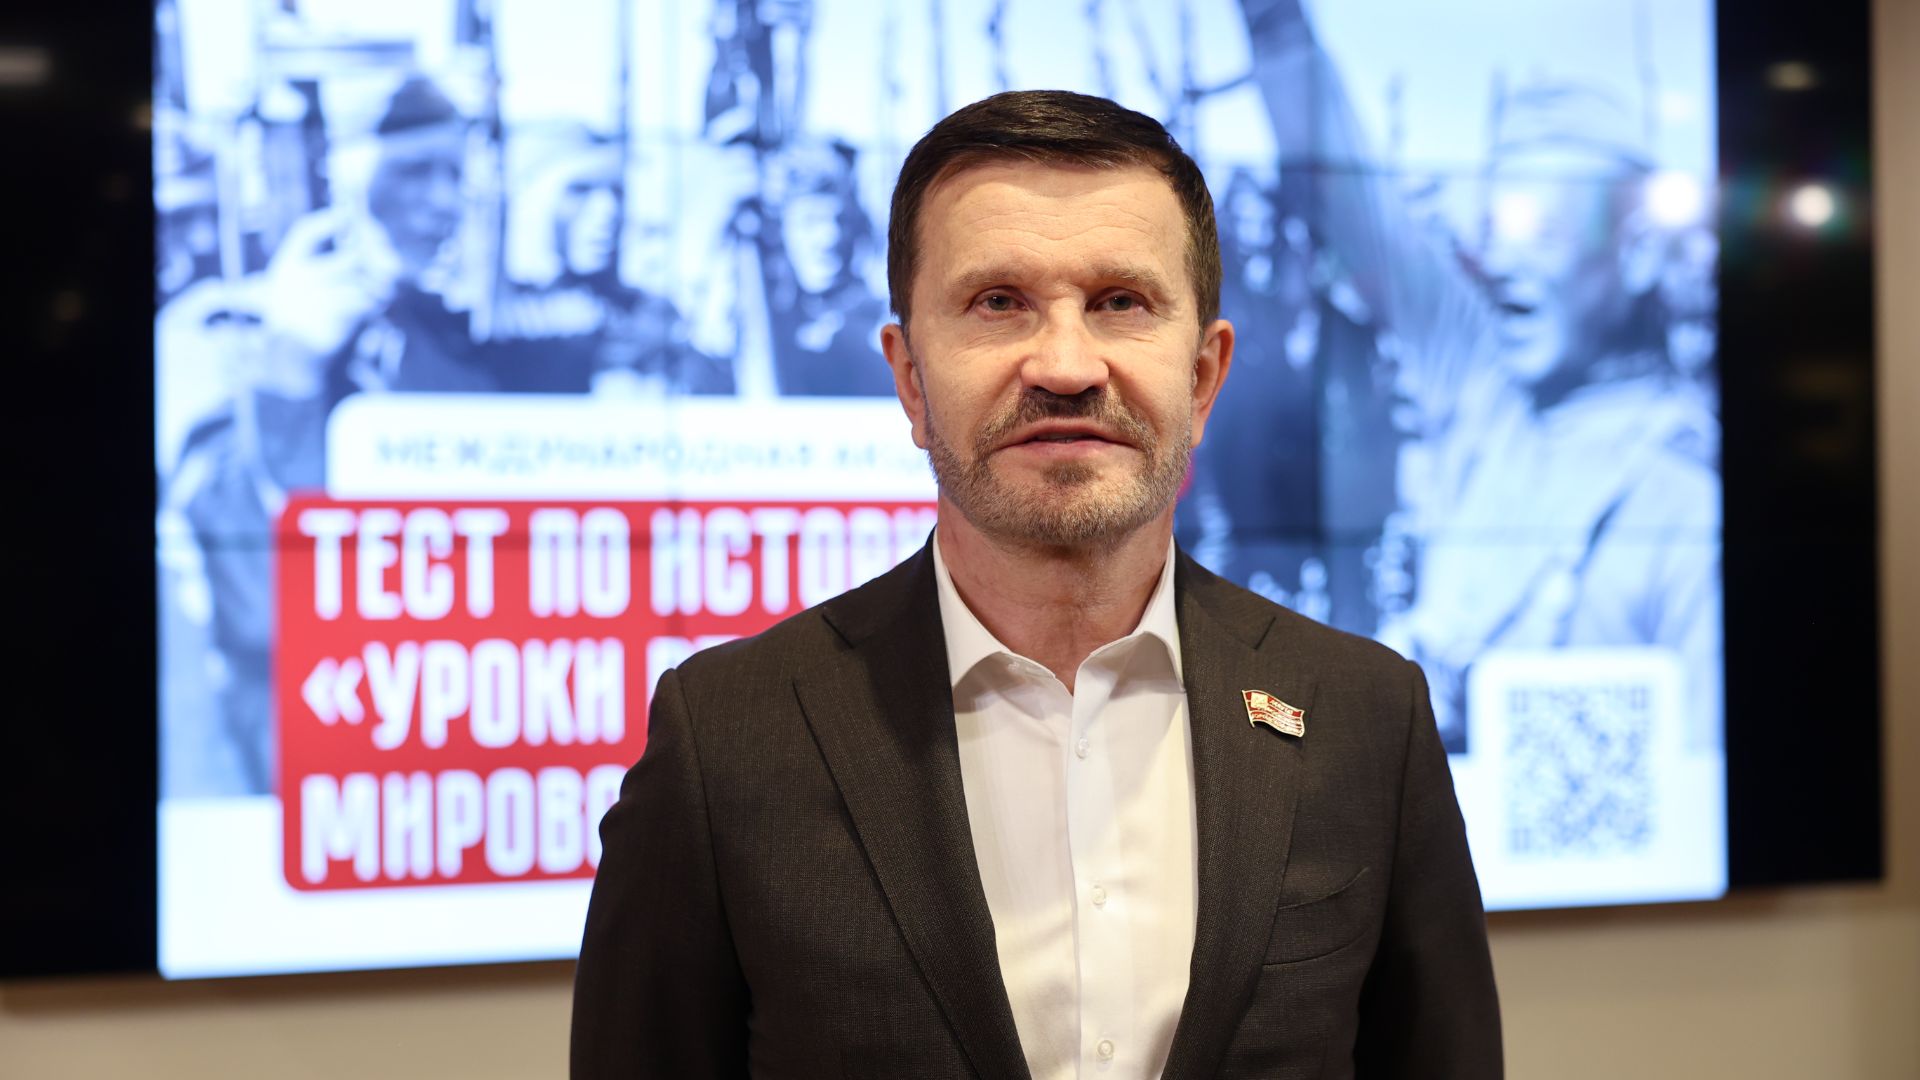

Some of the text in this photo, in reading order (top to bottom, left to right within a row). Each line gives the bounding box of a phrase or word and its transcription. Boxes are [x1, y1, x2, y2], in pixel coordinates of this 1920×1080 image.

[298, 508, 509, 620] ТЕСТ
[529, 508, 631, 618] ПО
[302, 638, 625, 750] «УРОКИ
